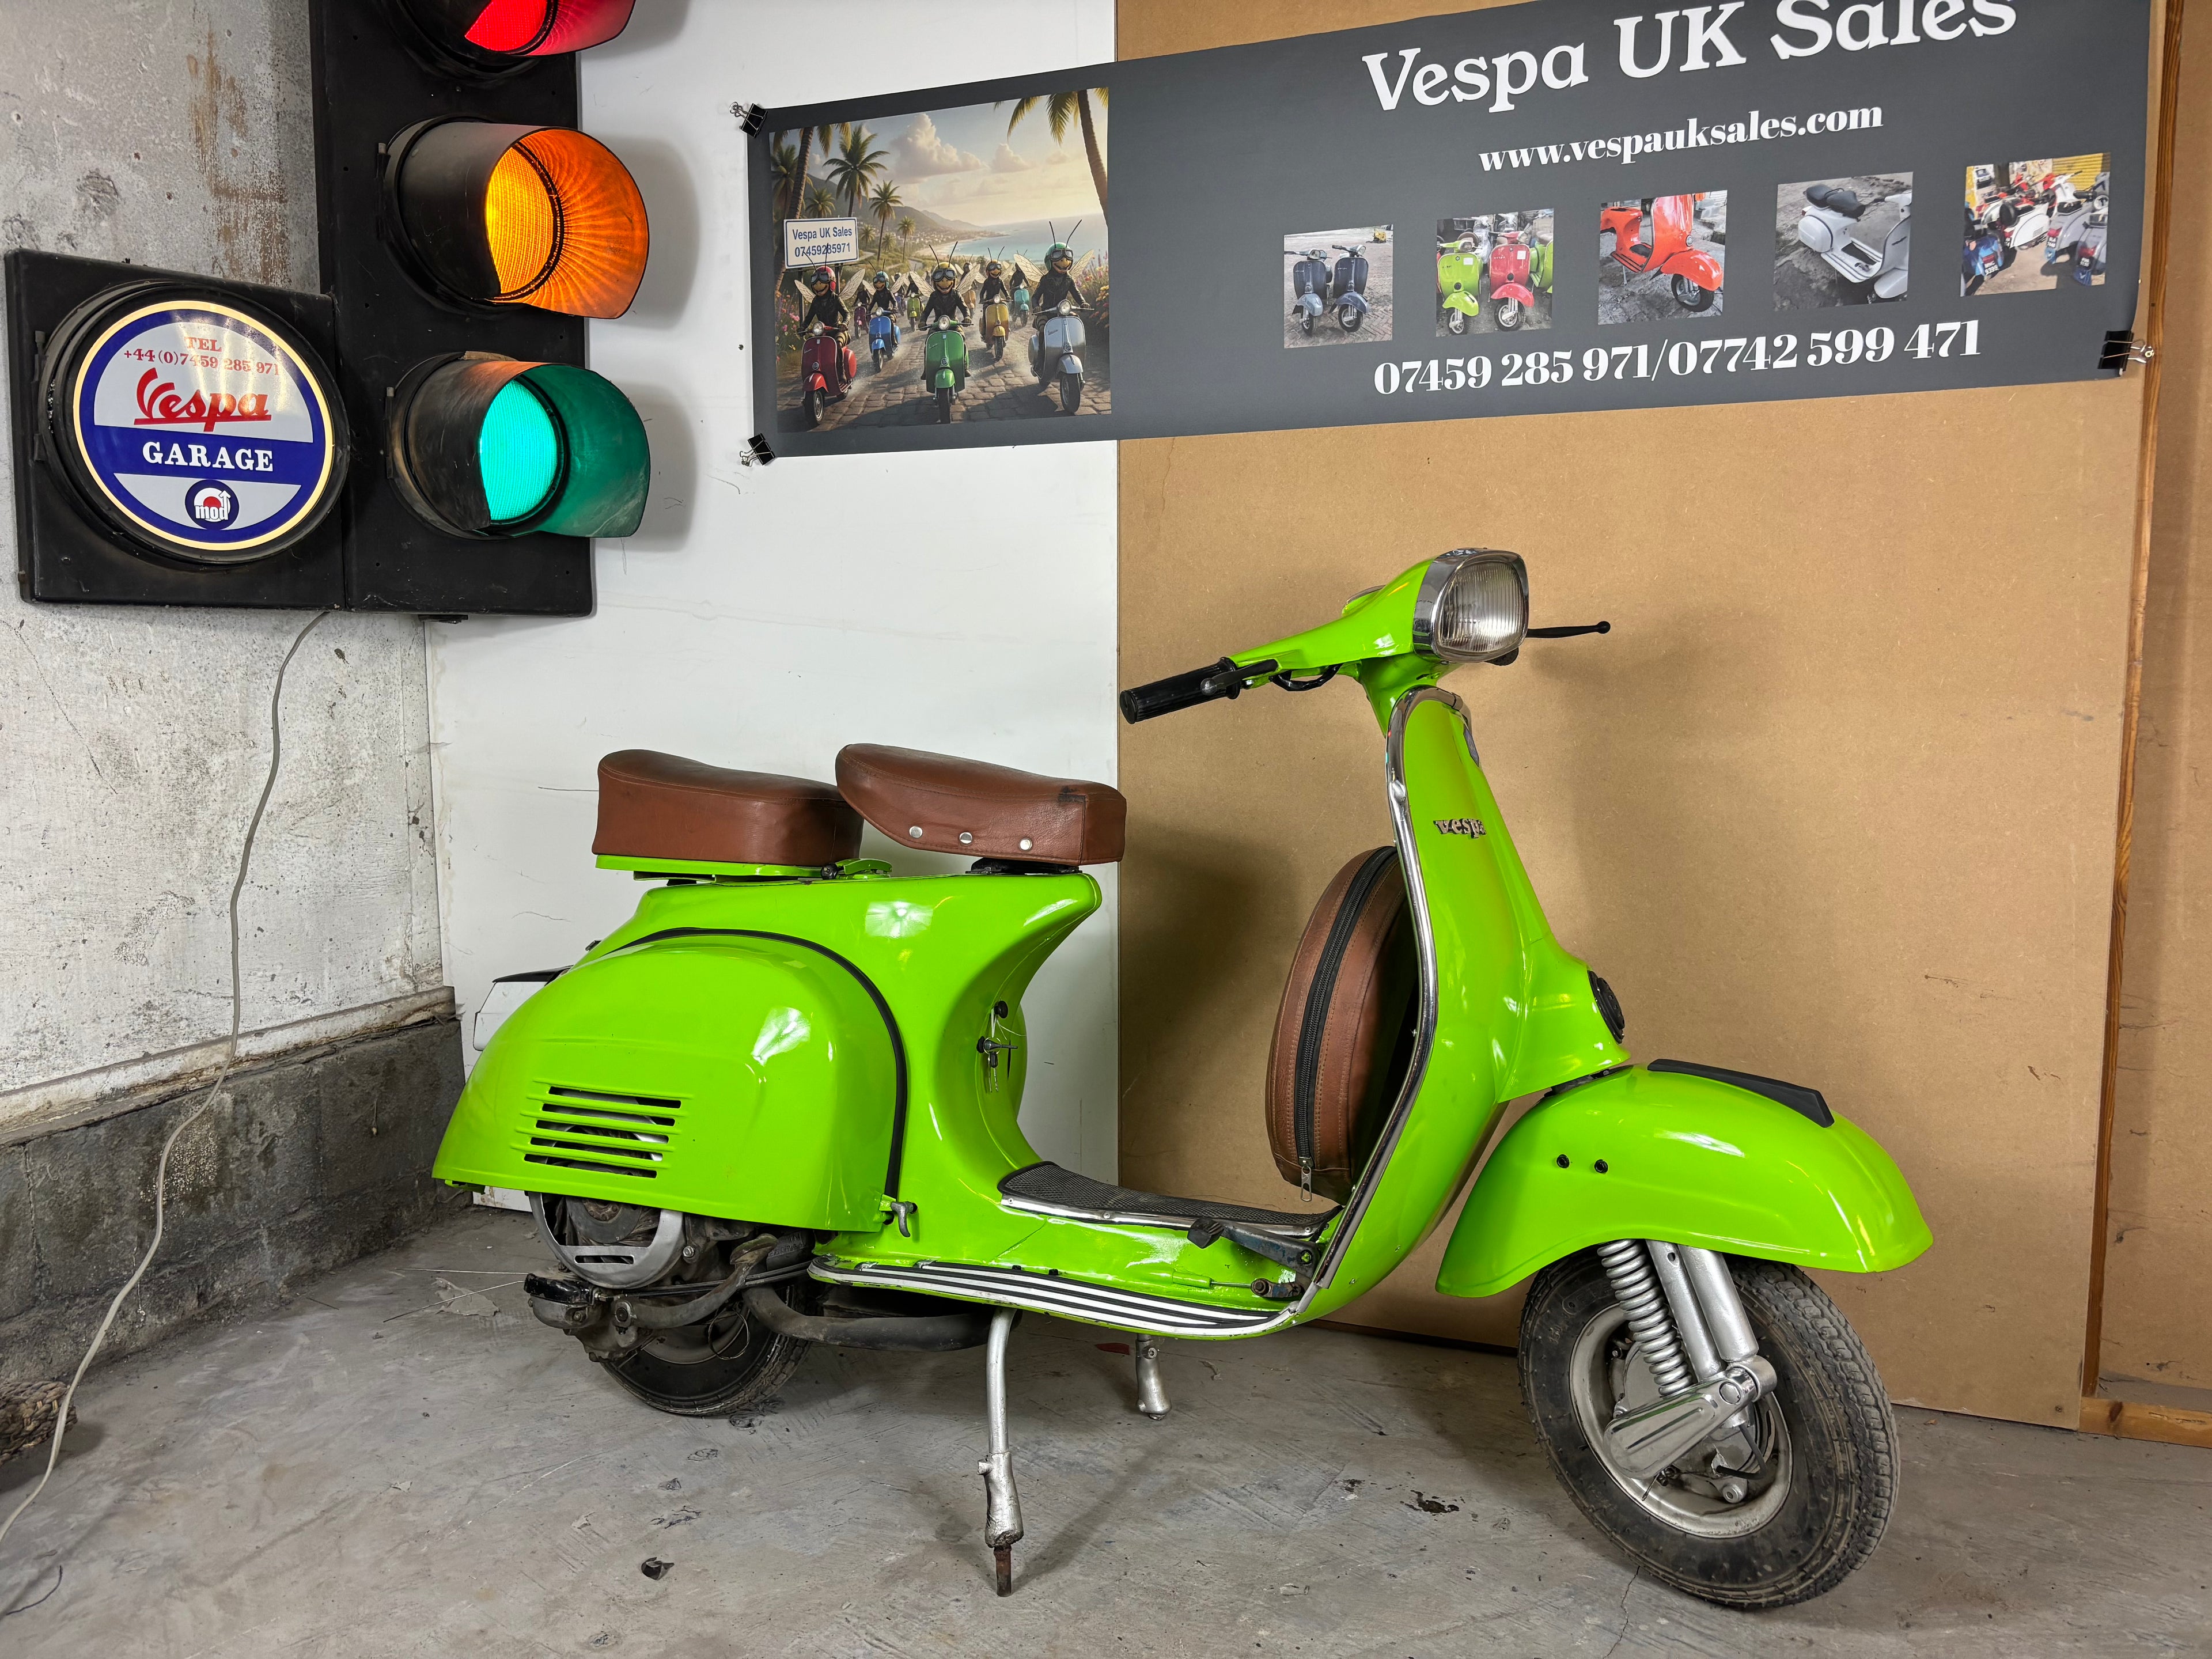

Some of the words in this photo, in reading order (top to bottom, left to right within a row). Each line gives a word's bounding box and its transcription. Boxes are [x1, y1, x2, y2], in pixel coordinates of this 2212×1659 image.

[1362, 42, 1589, 113] Vespa
[1613, 1, 1747, 78] UK
[1770, 0, 2016, 60] Sales
[1478, 107, 1883, 171] www.vespauksales.com
[792, 229, 817, 242] Vespa
[820, 228, 831, 238] UK
[833, 226, 853, 237] Sales
[795, 243, 851, 257] 07459285971
[184, 336, 222, 353] TEL
[1374, 355, 1492, 395] 07459
[1501, 350, 1573, 387] 285
[1582, 334, 1797, 381] 971/07742
[1807, 327, 1895, 366] 599
[1904, 320, 1981, 359] 471
[224, 358, 251, 372] 285
[256, 362, 279, 376] 971
[134, 367, 272, 432] Vespa
[142, 441, 273, 472] GARAGE
[195, 497, 230, 521] mod
